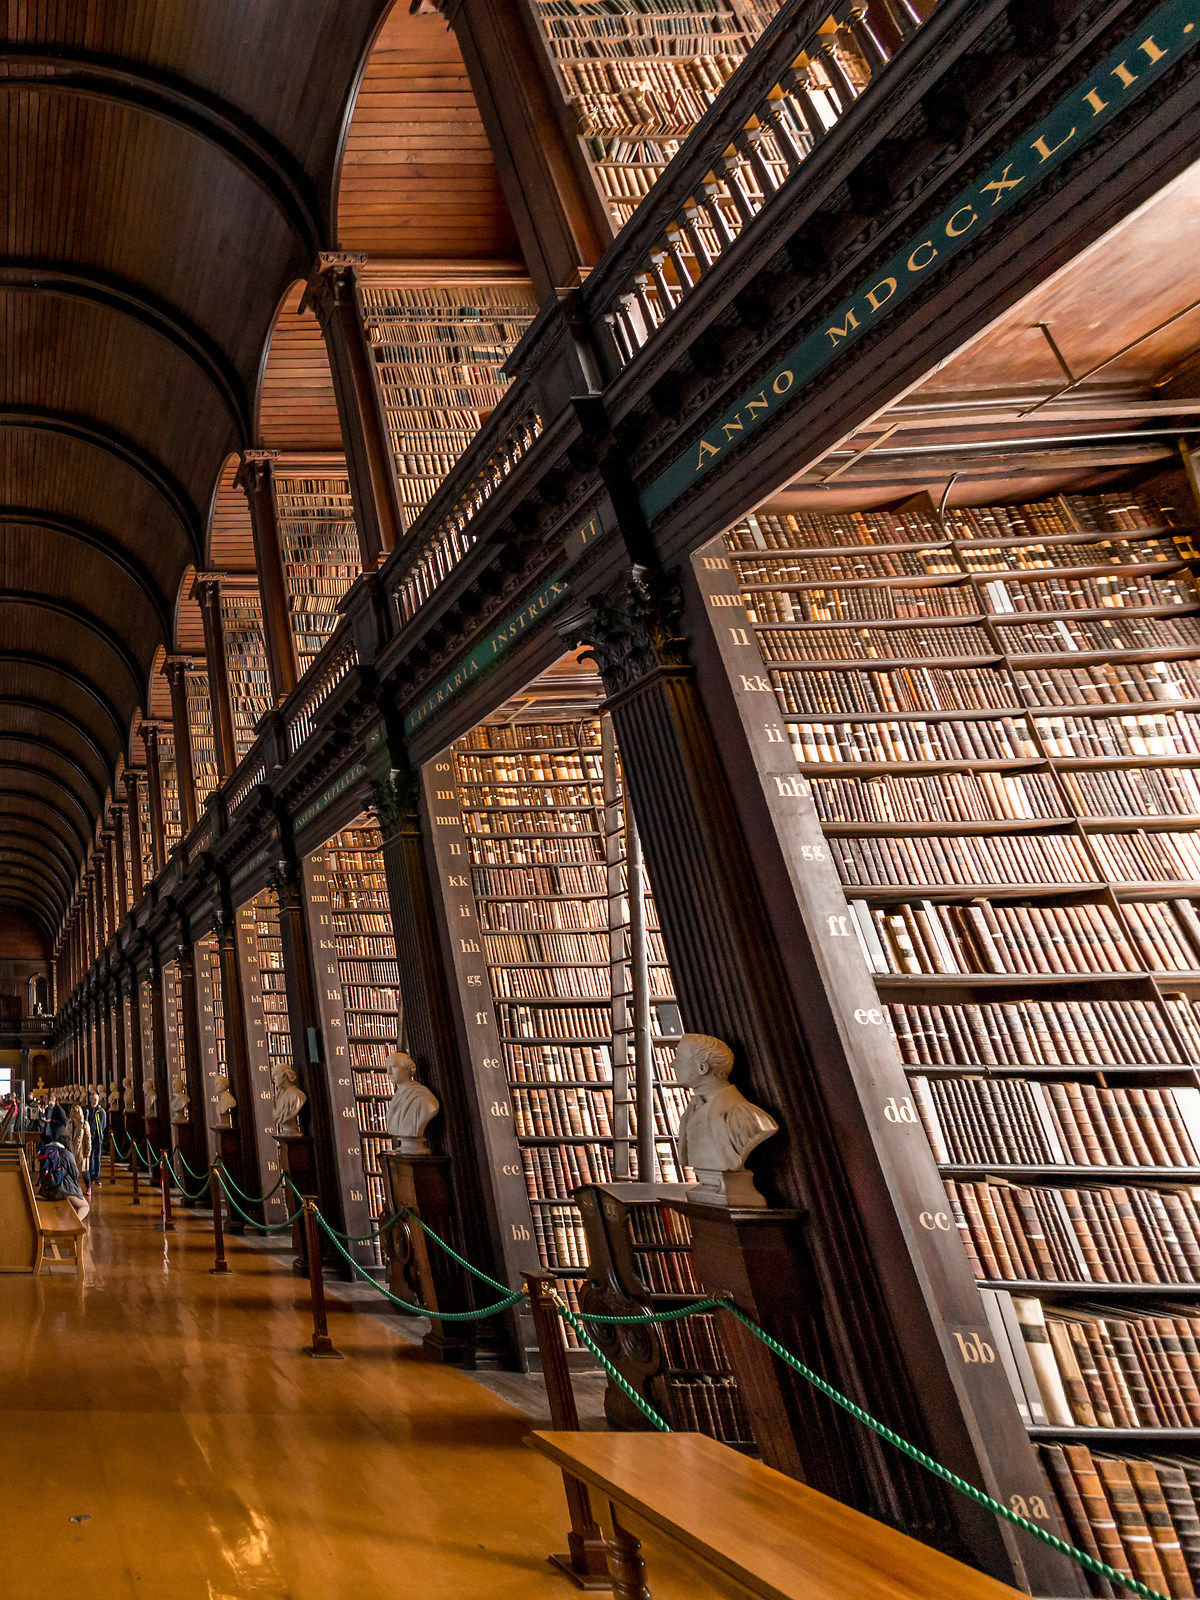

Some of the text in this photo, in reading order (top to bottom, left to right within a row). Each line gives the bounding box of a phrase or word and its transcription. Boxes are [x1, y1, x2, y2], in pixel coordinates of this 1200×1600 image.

[695, 367, 795, 471] ANNO
[701, 557, 730, 570] nn
[709, 592, 742, 606] mm
[729, 628, 751, 646] ll
[739, 674, 771, 692] kk
[765, 724, 784, 743] ii
[435, 763, 449, 771] oo
[775, 777, 807, 797] hh
[437, 789, 455, 799] nn
[436, 814, 460, 826] mm
[450, 843, 461, 855] ll
[800, 843, 825, 861] gg
[449, 875, 468, 887] kk
[460, 905, 471, 917] ii
[320, 915, 329, 925] ll
[826, 916, 850, 936] ff
[320, 939, 335, 948] kk
[461, 939, 481, 953] hh
[327, 965, 335, 974] ii
[467, 974, 482, 986] gg
[327, 989, 341, 1000] hh
[475, 1012, 489, 1025] ff
[854, 1006, 882, 1025] ee
[330, 1018, 342, 1027] gg
[335, 1046, 345, 1055] ff
[483, 1057, 500, 1068] ee
[338, 1077, 350, 1086] ee
[343, 1108, 356, 1118] dd
[490, 1102, 510, 1117] dd
[884, 1097, 919, 1124] dd
[348, 1146, 360, 1156] cc
[502, 1164, 520, 1175] cc
[350, 1190, 363, 1201] bb
[919, 1211, 951, 1231] cc
[512, 1224, 530, 1241] bb
[952, 1333, 995, 1363] bb
[1010, 1496, 1049, 1518] aa
